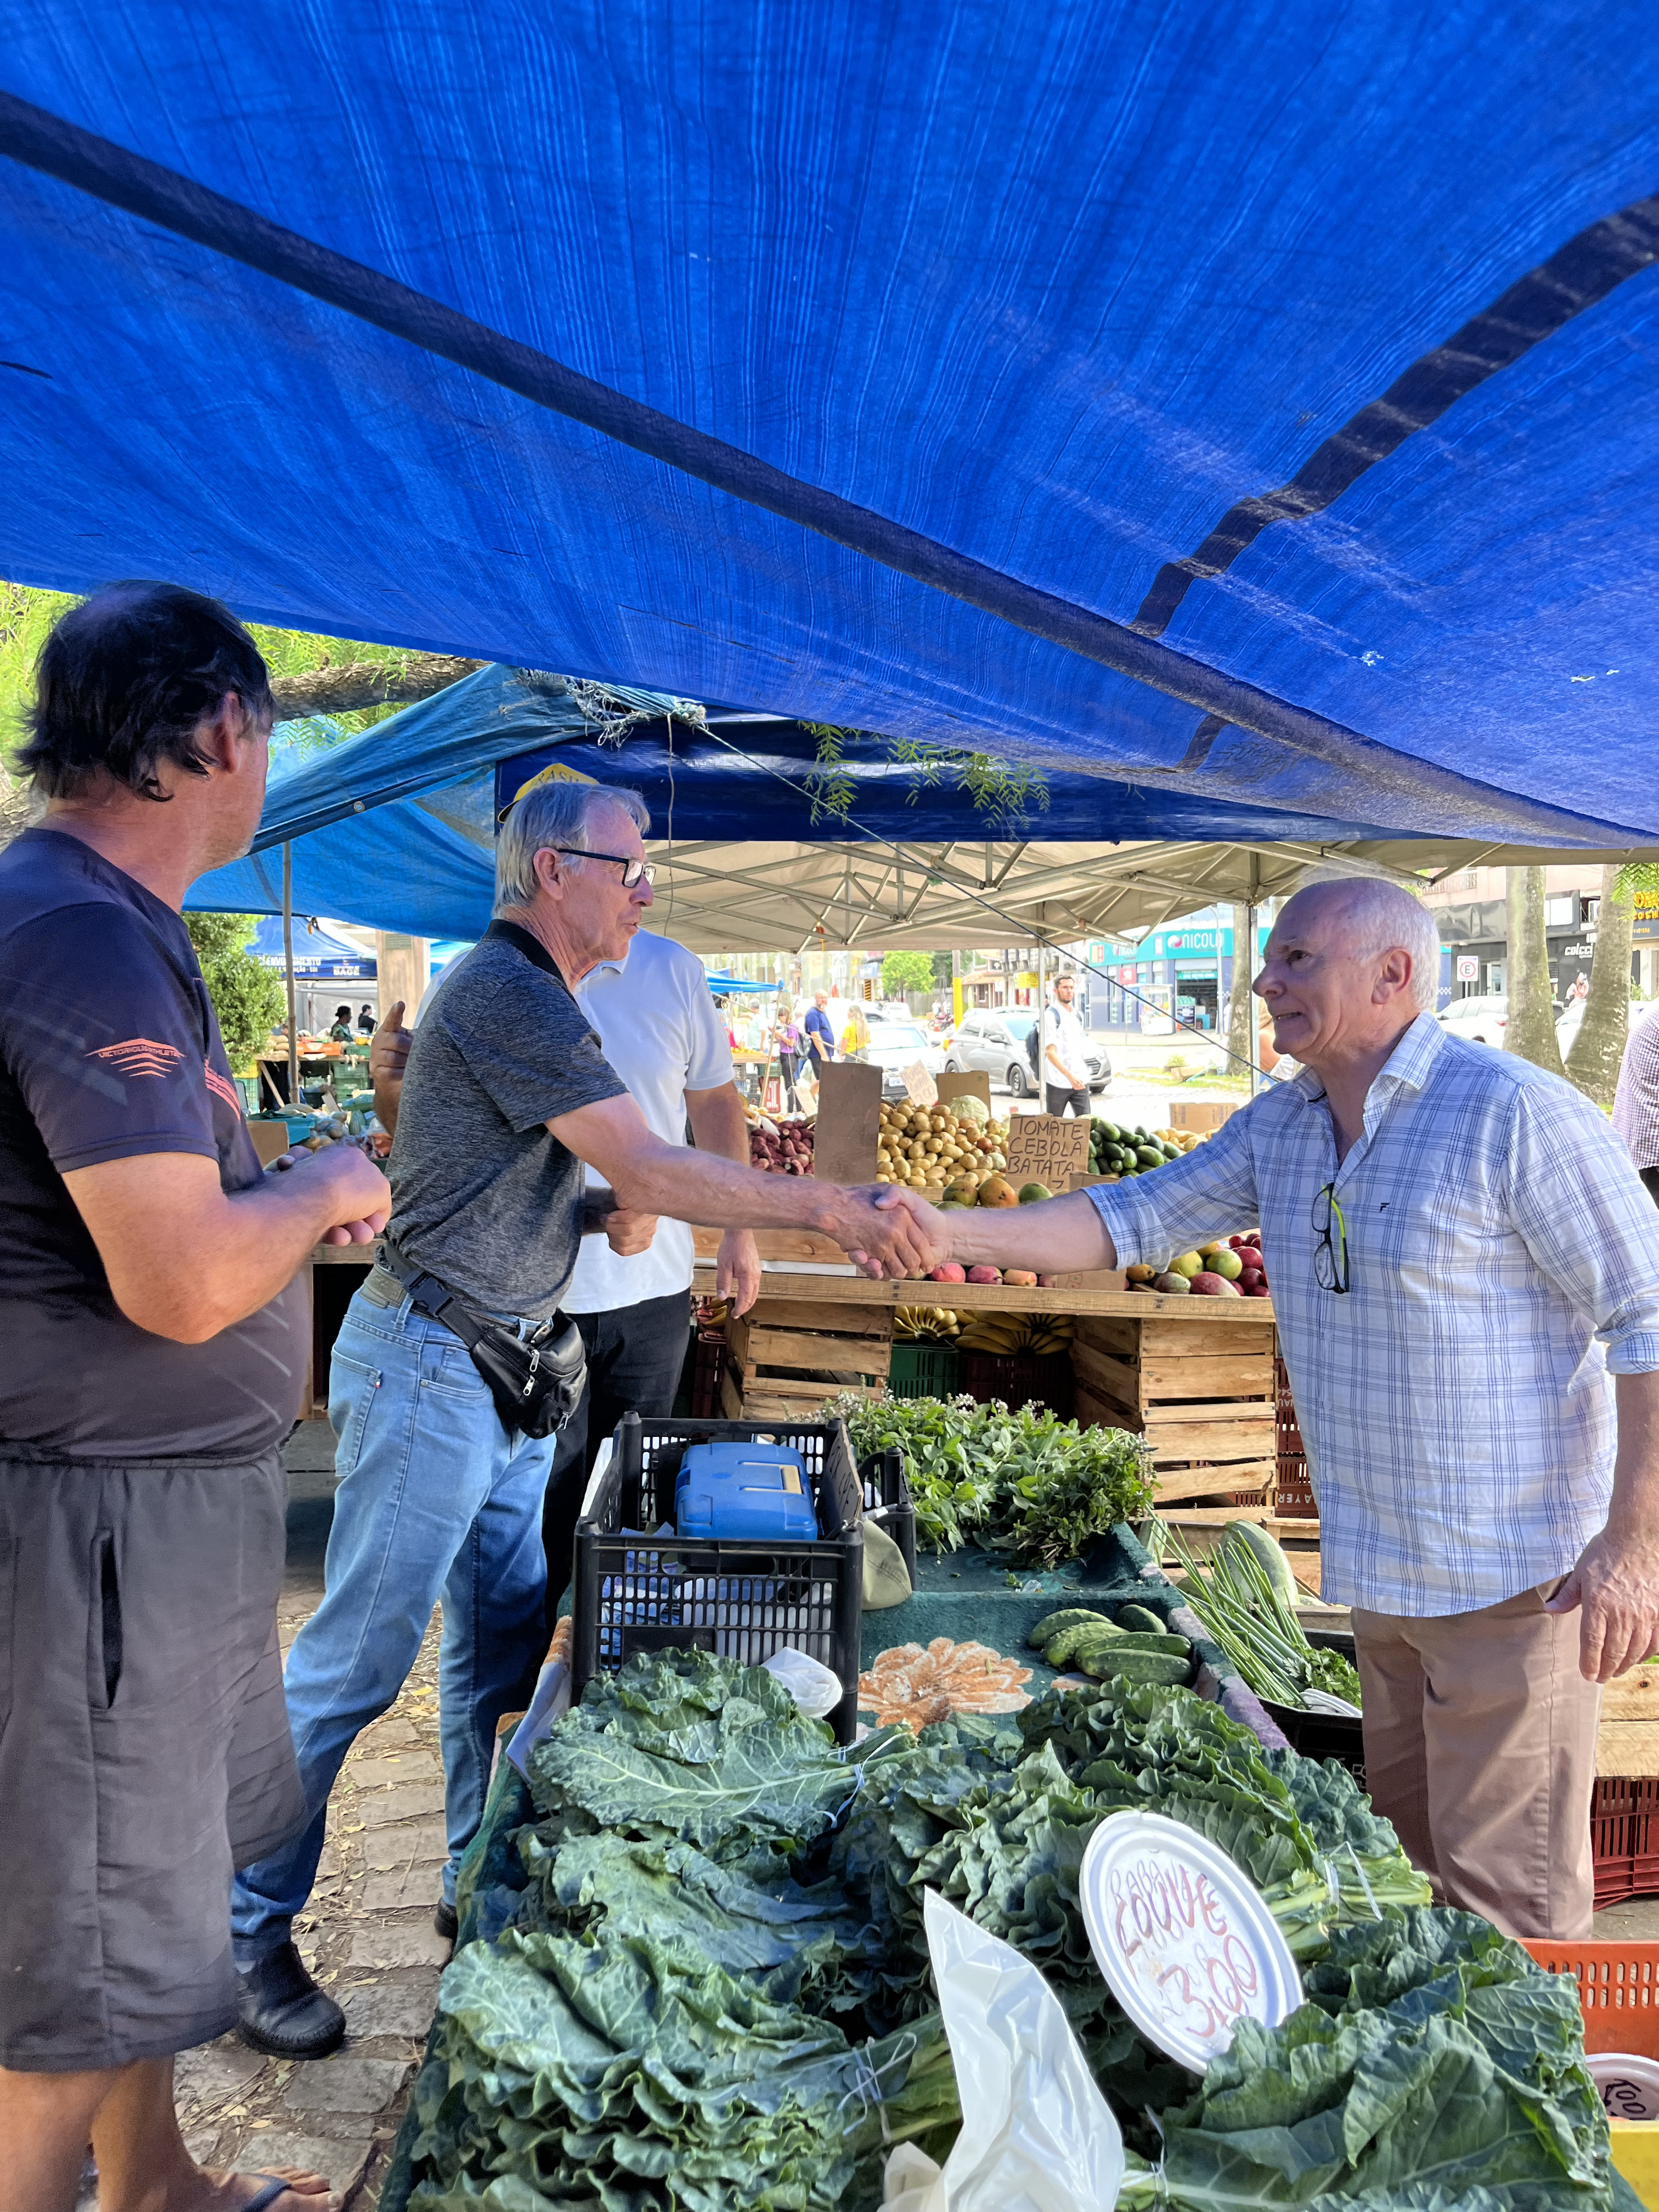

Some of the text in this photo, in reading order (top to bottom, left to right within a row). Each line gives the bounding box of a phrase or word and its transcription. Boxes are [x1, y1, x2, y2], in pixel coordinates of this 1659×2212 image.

[1565, 943, 1594, 956] colcci
[1465, 965, 1470, 974] E
[1011, 1115, 1083, 1140] TOMATE
[1010, 1137, 1081, 1156] CEBOLA
[1007, 1156, 1074, 1176] BATATA
